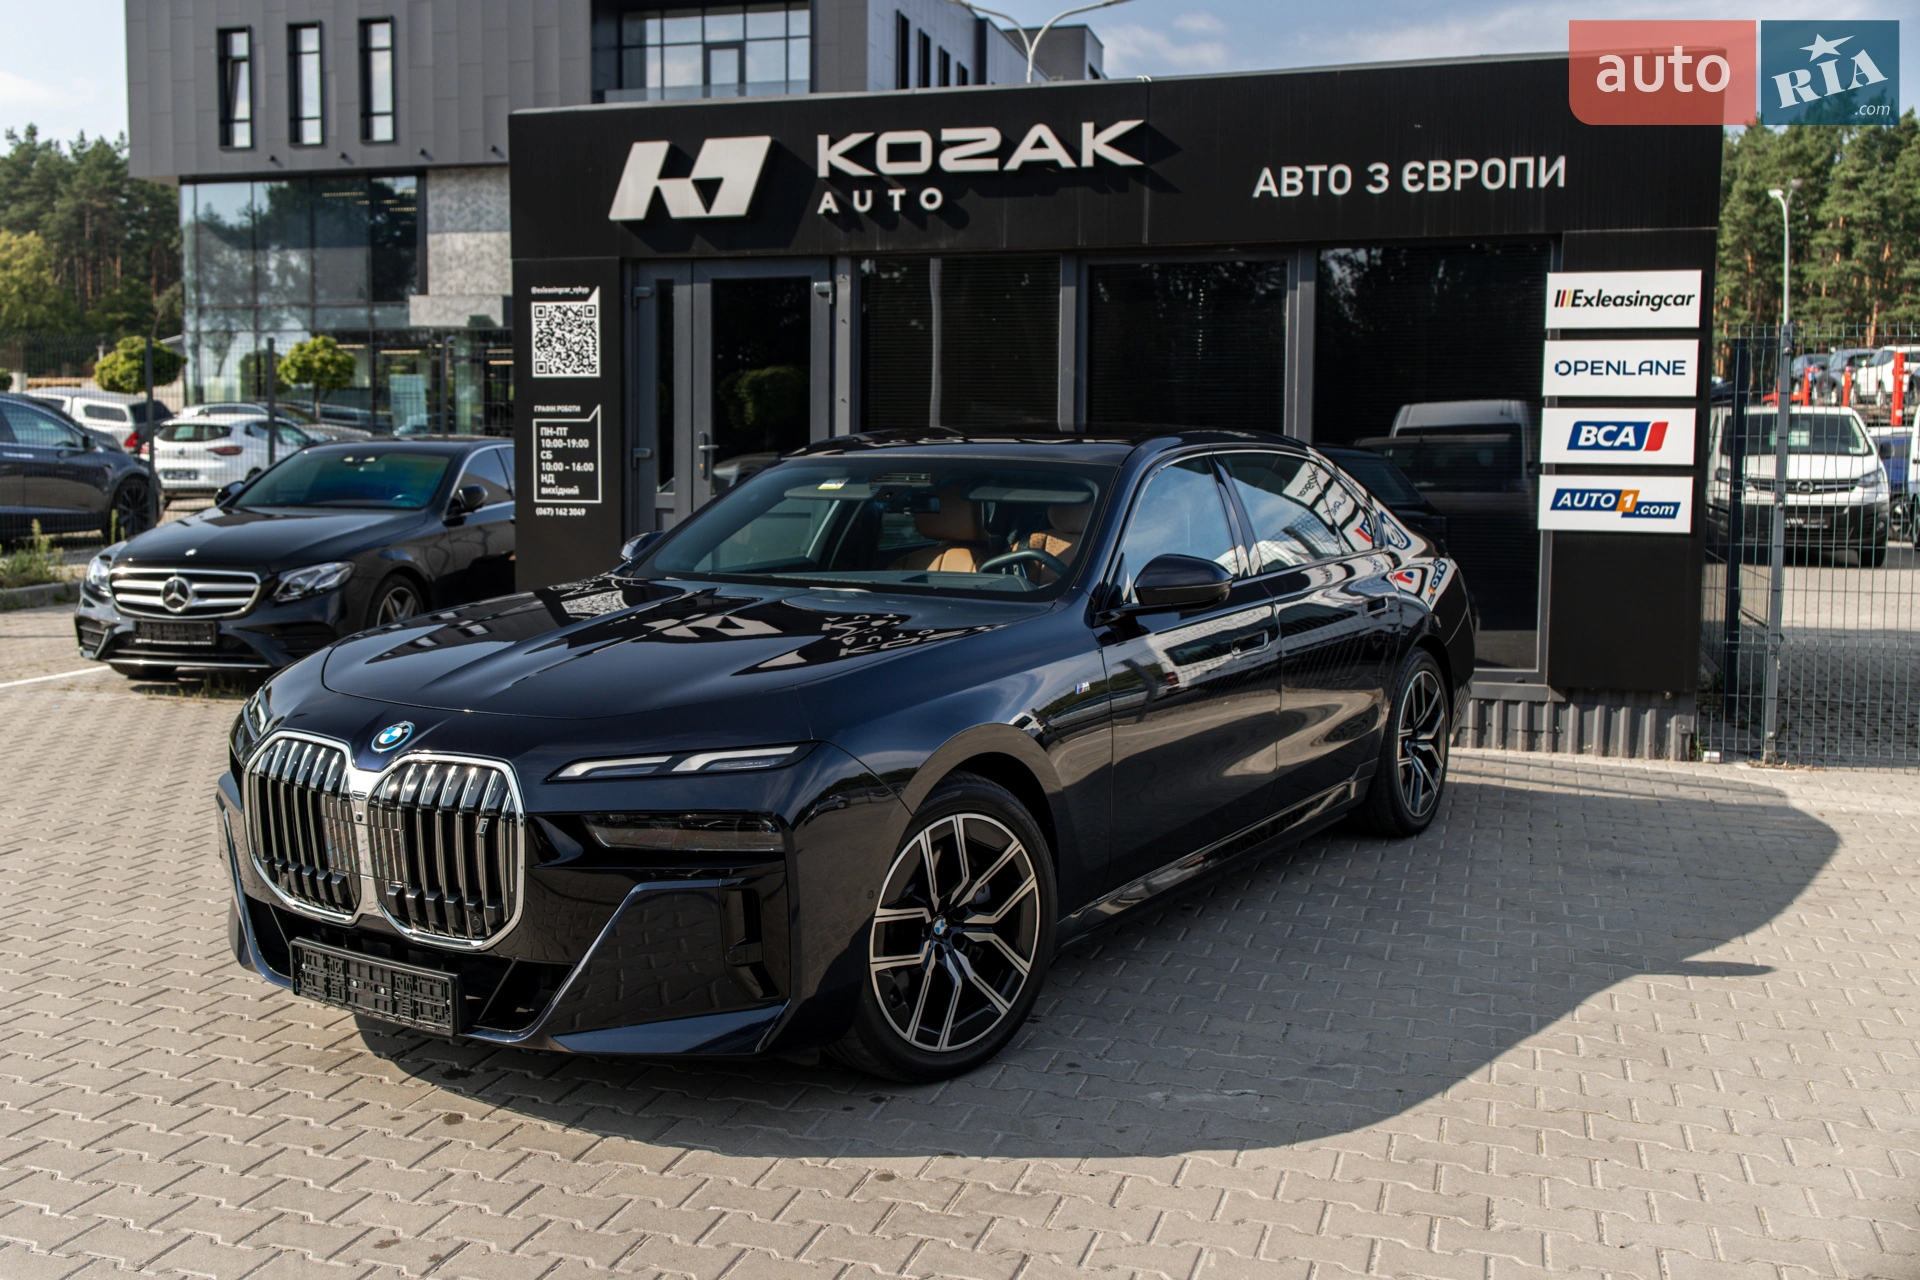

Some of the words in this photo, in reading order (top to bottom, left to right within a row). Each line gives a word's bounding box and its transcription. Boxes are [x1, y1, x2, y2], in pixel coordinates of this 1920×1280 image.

[817, 119, 1144, 178] KOZAK
[1252, 163, 1352, 198] АВТО
[1402, 155, 1566, 193] ЄВРОПИ
[817, 187, 943, 214] AUTO
[1570, 288, 1696, 312] Exleasingcar
[1554, 359, 1687, 377] OPENLANE
[557, 404, 581, 413] РОБОТИ
[540, 426, 569, 437] ПН-ПТ
[1578, 425, 1637, 448] BCA
[540, 438, 590, 449] 10:00-19:00
[540, 450, 553, 460] СБ
[541, 461, 565, 472] 10:00
[571, 461, 595, 472] 16:00
[540, 473, 556, 485] НД
[540, 485, 580, 497] вихідний
